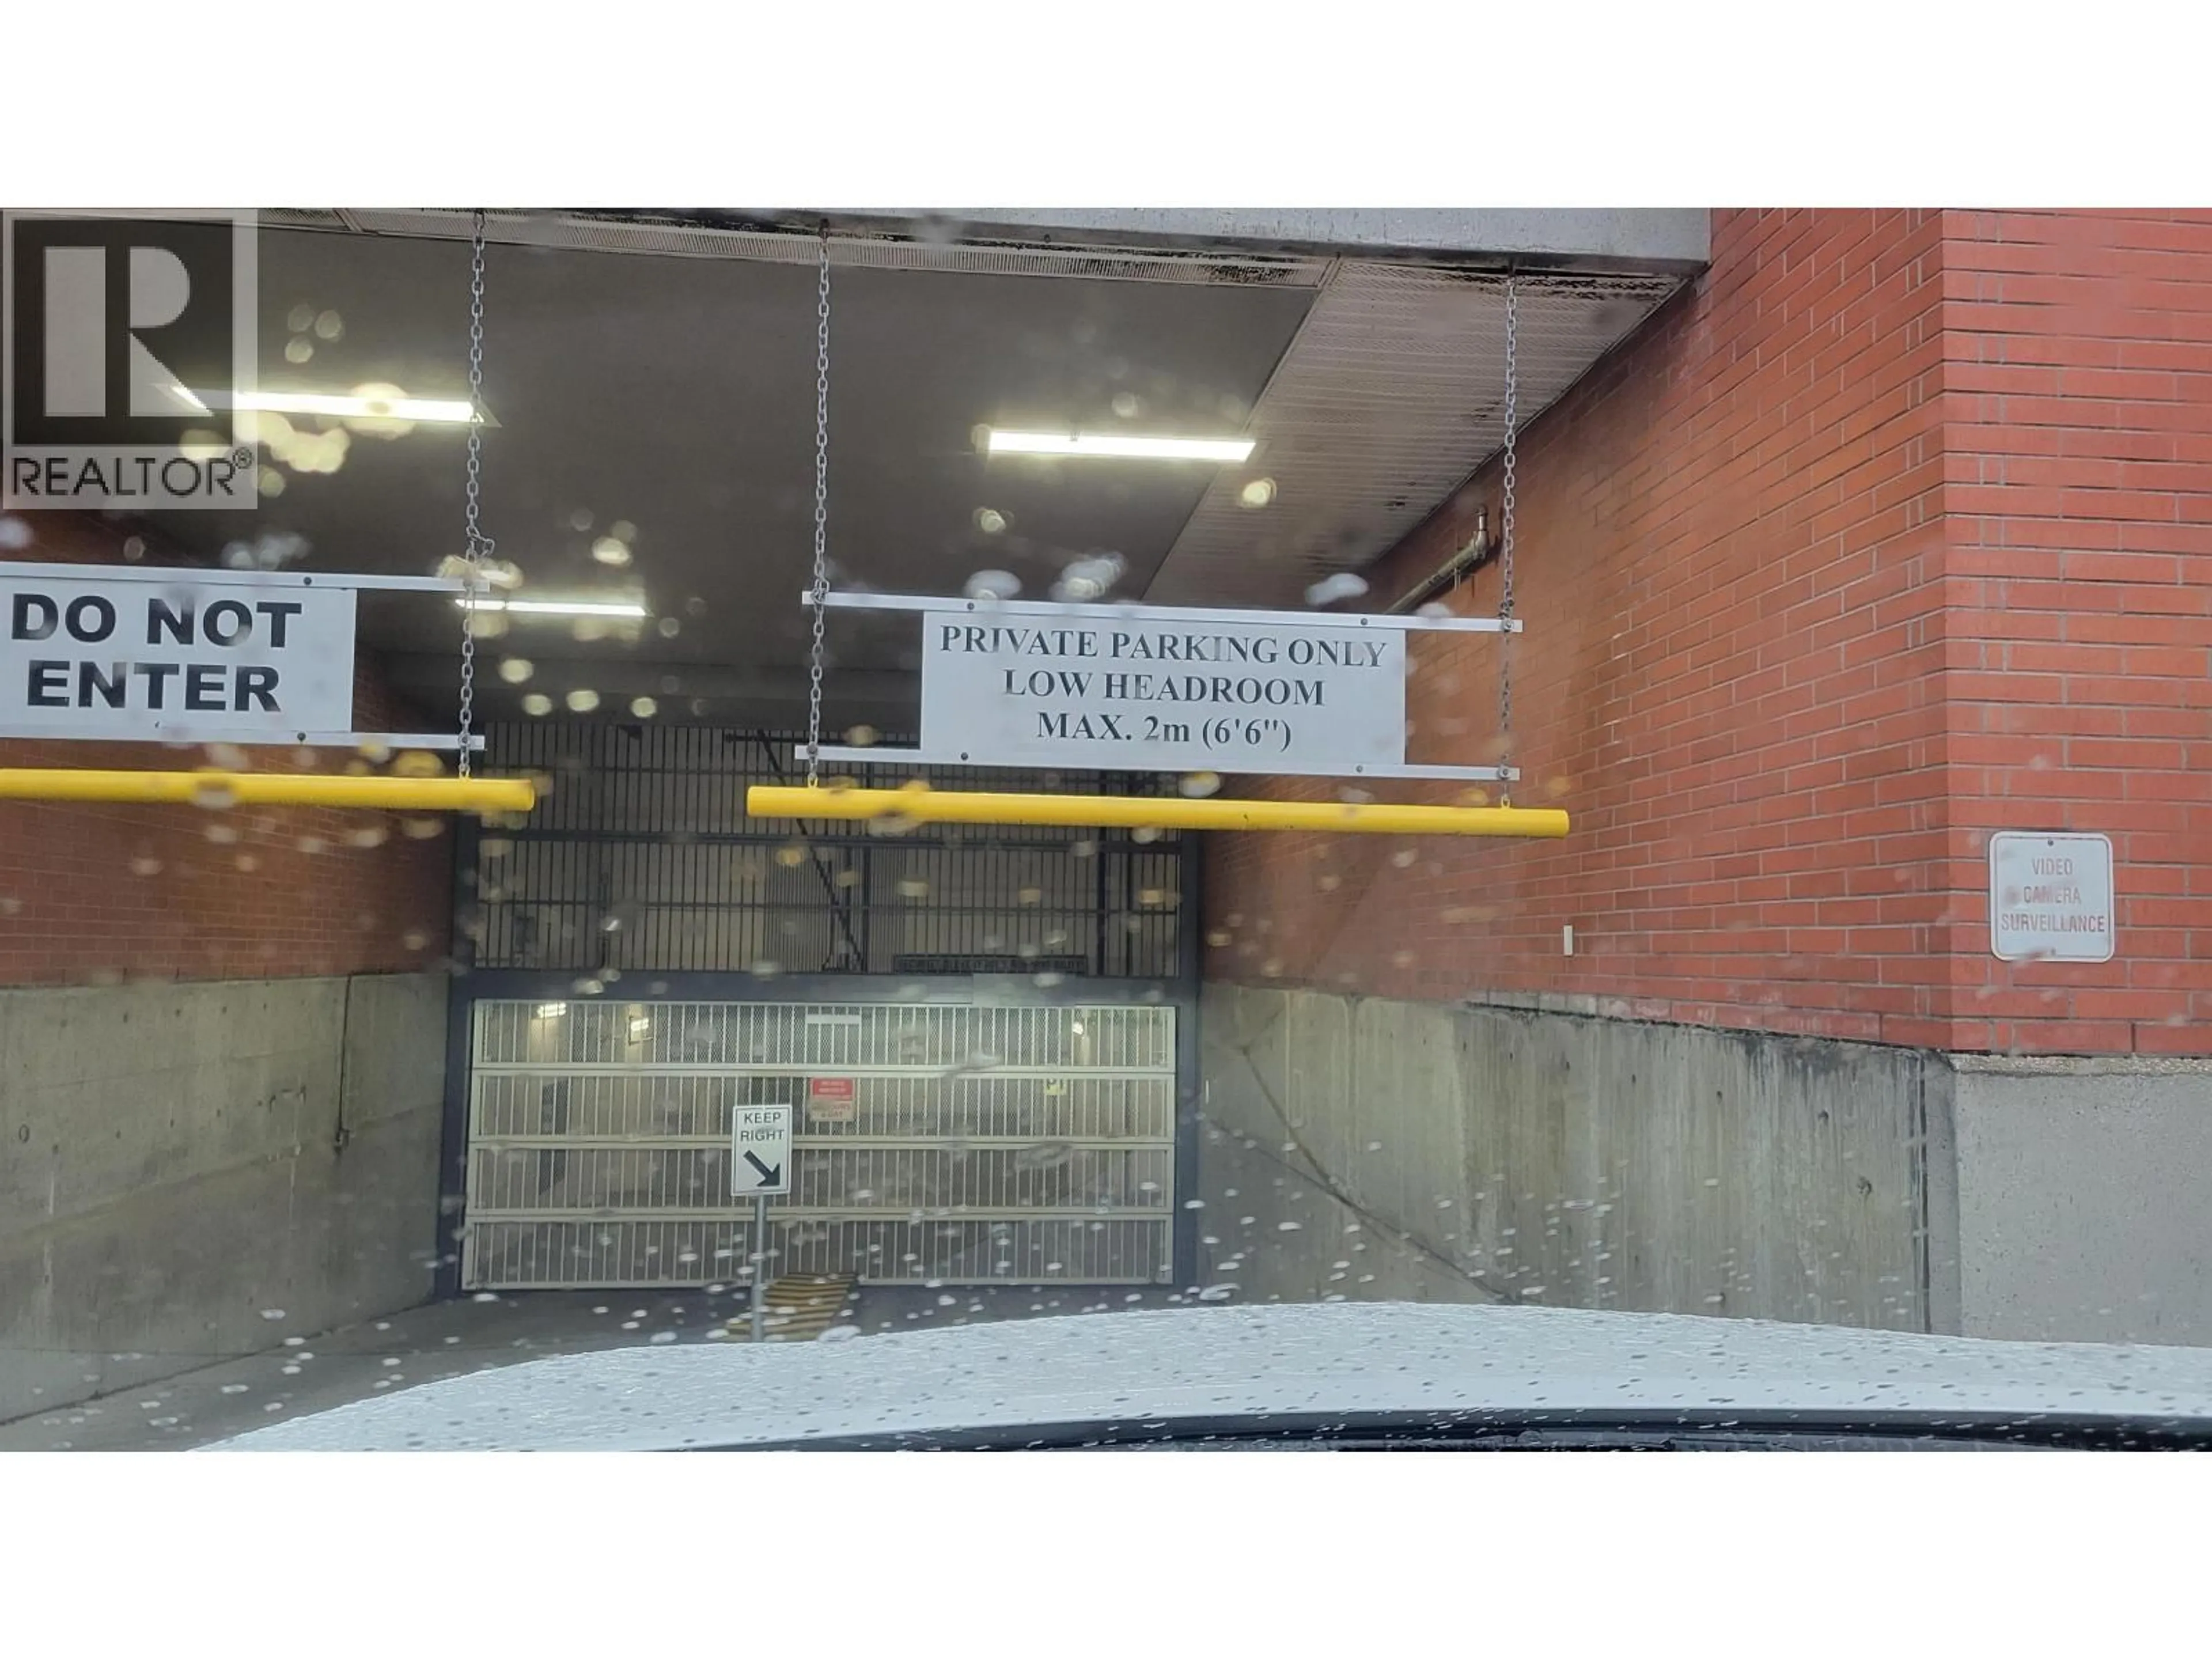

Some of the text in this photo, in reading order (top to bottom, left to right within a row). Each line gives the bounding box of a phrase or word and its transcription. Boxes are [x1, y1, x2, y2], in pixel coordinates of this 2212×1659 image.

[12, 593, 301, 647] DO NOT
[940, 625, 1388, 667] PRIVATE PARKING ONLY
[28, 660, 281, 711] ENTER
[1003, 669, 1324, 706] LOW HEADROOM
[1037, 712, 1292, 752] MAX. 2m (6'6")
[2032, 859, 2073, 875] VIDEO
[2001, 914, 2105, 932] SURVEILLANCE
[740, 1130, 784, 1142] RIGHT
[744, 1112, 781, 1124] KEEP
